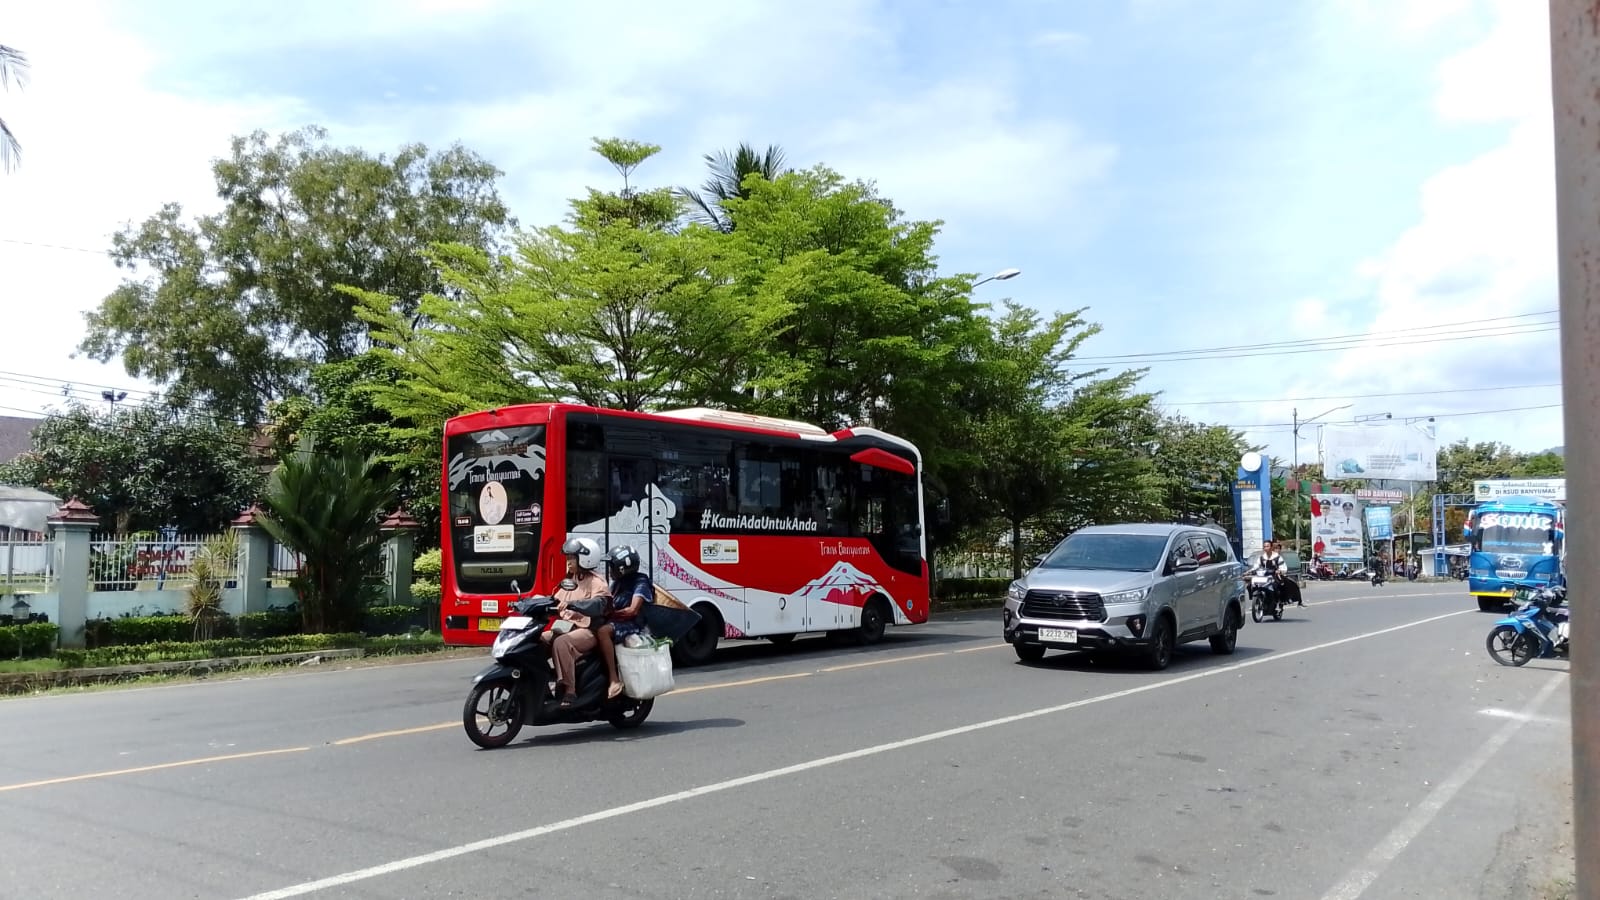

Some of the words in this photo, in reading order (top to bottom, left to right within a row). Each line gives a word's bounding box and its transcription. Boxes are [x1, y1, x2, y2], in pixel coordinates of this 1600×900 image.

[468, 471, 485, 484] Trans
[487, 469, 521, 483] Banyumas
[700, 509, 817, 531] #KamiAdaUntukAnda
[819, 541, 837, 556] Trans
[838, 541, 871, 557] Banyumas
